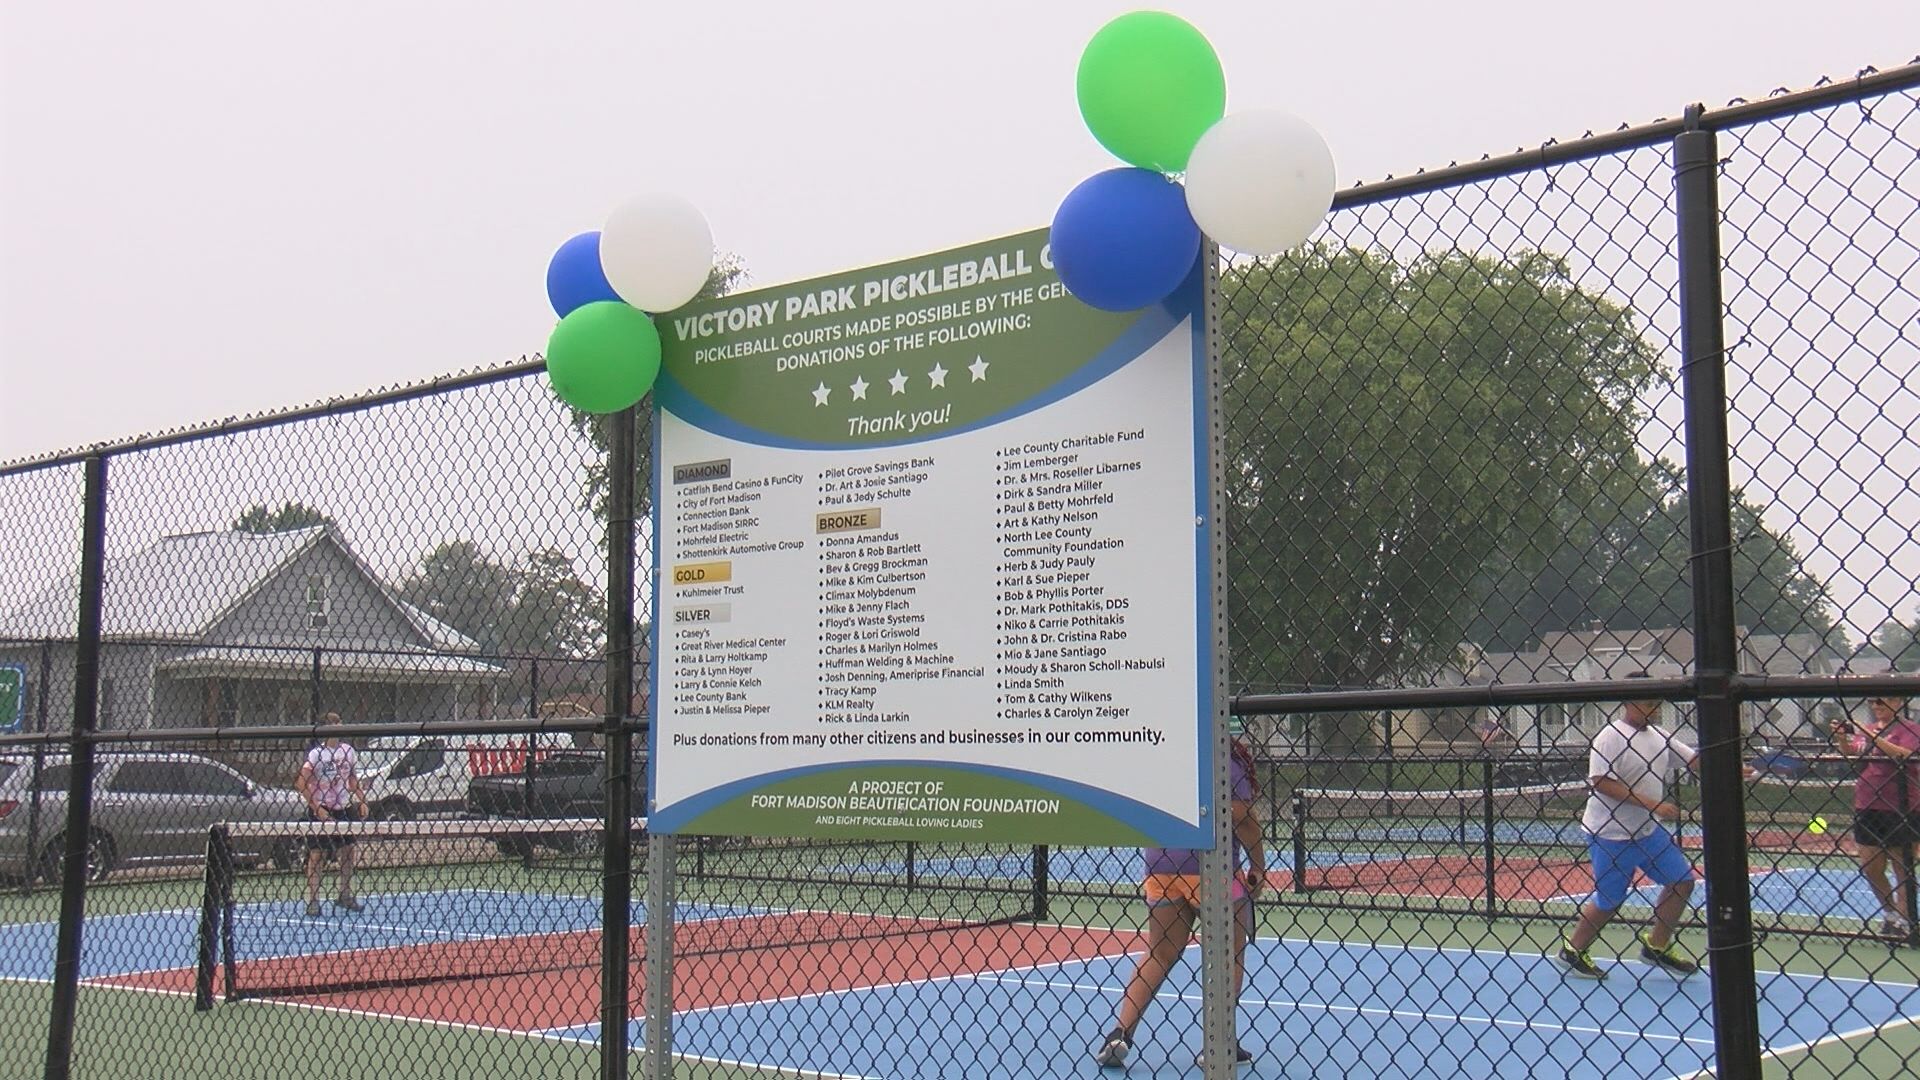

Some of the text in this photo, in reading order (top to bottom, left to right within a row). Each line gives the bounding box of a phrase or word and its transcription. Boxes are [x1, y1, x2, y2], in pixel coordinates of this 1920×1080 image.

[675, 300, 779, 341] VICTORY
[786, 285, 856, 321] PARK
[864, 250, 1032, 307] PICKLEBALL
[696, 337, 778, 364] PICKLEBALL
[783, 326, 841, 348] COURTS
[846, 317, 891, 338] MADE
[896, 301, 971, 328] POSSIBLE
[976, 298, 997, 313] BY
[1001, 290, 1033, 308] THE
[777, 314, 1031, 372] DONATIONS OF THE FOLLOWING:
[848, 403, 951, 436] Thank you!
[1004, 429, 1145, 457] Lee County Charitable Fund
[825, 457, 935, 479] Pilot Grove Savings Bank
[1003, 455, 1079, 471] Jim Lemberger
[677, 464, 728, 481] DIAMOND
[683, 474, 804, 496] Catfish Bend Casino & FunCity
[1004, 480, 1103, 500] Dirk & Sandra Miller
[683, 492, 761, 510] City of Fort Madison
[1004, 493, 1114, 514] Paul & Betty Mohrfeld
[683, 505, 750, 522] Connection Bank
[683, 518, 760, 534] Fort Madison SIRRC
[819, 514, 868, 530] BRONZE
[683, 532, 749, 546] Mohrfeld Electric
[826, 532, 899, 547] Donna Amandus
[1004, 527, 1092, 543] North Lee County
[682, 541, 804, 559] Shottenkirk Automotive Group
[826, 544, 922, 560] Sharon & Rob Bartlett
[1003, 539, 1124, 558] Community Foundation
[676, 569, 705, 582] GOLD
[682, 586, 744, 598] Kuhlmeier Trust
[825, 587, 916, 601] Climax Molybdenum
[1004, 586, 1104, 601] Bob & Phyllis Porter
[675, 609, 711, 622] SILVER
[1004, 599, 1129, 616] Dr. Mark Pothitakis, DDS
[825, 615, 925, 629] Floyd's Waste Systems
[1004, 615, 1125, 630] Niko & Carrie Pothitakis
[681, 628, 710, 639] Casey's
[825, 627, 920, 643] Roger & Lori Griswold
[681, 638, 786, 651] Great River Medical Center
[825, 641, 938, 655] Charles & Marilyn Holmes
[825, 654, 954, 668] Huffman Welding & Machine
[1004, 659, 1166, 676] Moudy & Sharon Scholl-Nabulsi
[825, 667, 985, 682] Josh Denning, Ameriprise Financial
[1004, 677, 1064, 689] Linda Smith
[680, 691, 747, 703] Lee County Bank
[825, 686, 877, 697] Tracy Kamp
[825, 699, 874, 710] KLM Realty
[1004, 706, 1130, 719] Charles & Carolyn Zeiger
[674, 727, 1165, 747] Plus donations from many other citizens and businesses in our community.
[849, 781, 944, 795] A PROJECT OF
[752, 795, 1059, 814] FORT MADISON BEAUTIFICATION FOUNDATION
[816, 816, 983, 828] AND EIGHT PICKLEBALL LOVING LADIES
